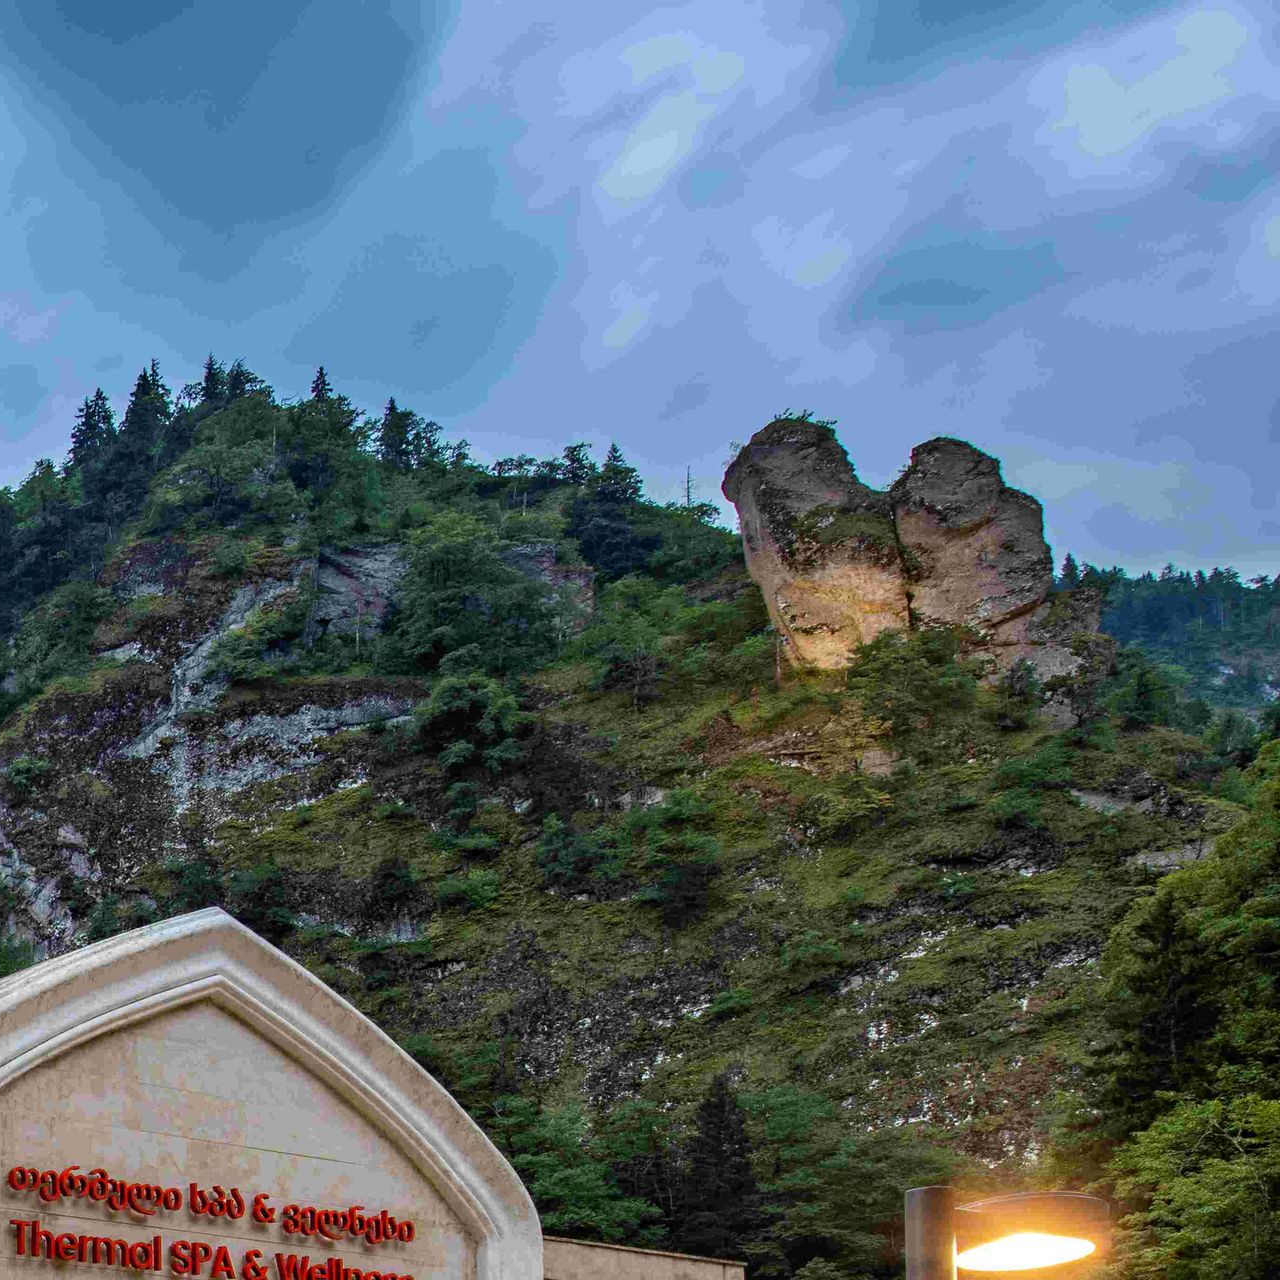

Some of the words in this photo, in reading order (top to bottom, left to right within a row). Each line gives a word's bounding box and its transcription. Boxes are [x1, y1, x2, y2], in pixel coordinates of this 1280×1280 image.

[8, 1165, 183, 1215] თერმული
[190, 1183, 246, 1219] სპა
[252, 1193, 276, 1223] &
[282, 1204, 416, 1245] ველნესი
[10, 1219, 162, 1271] Thermal
[171, 1240, 236, 1279] SPA
